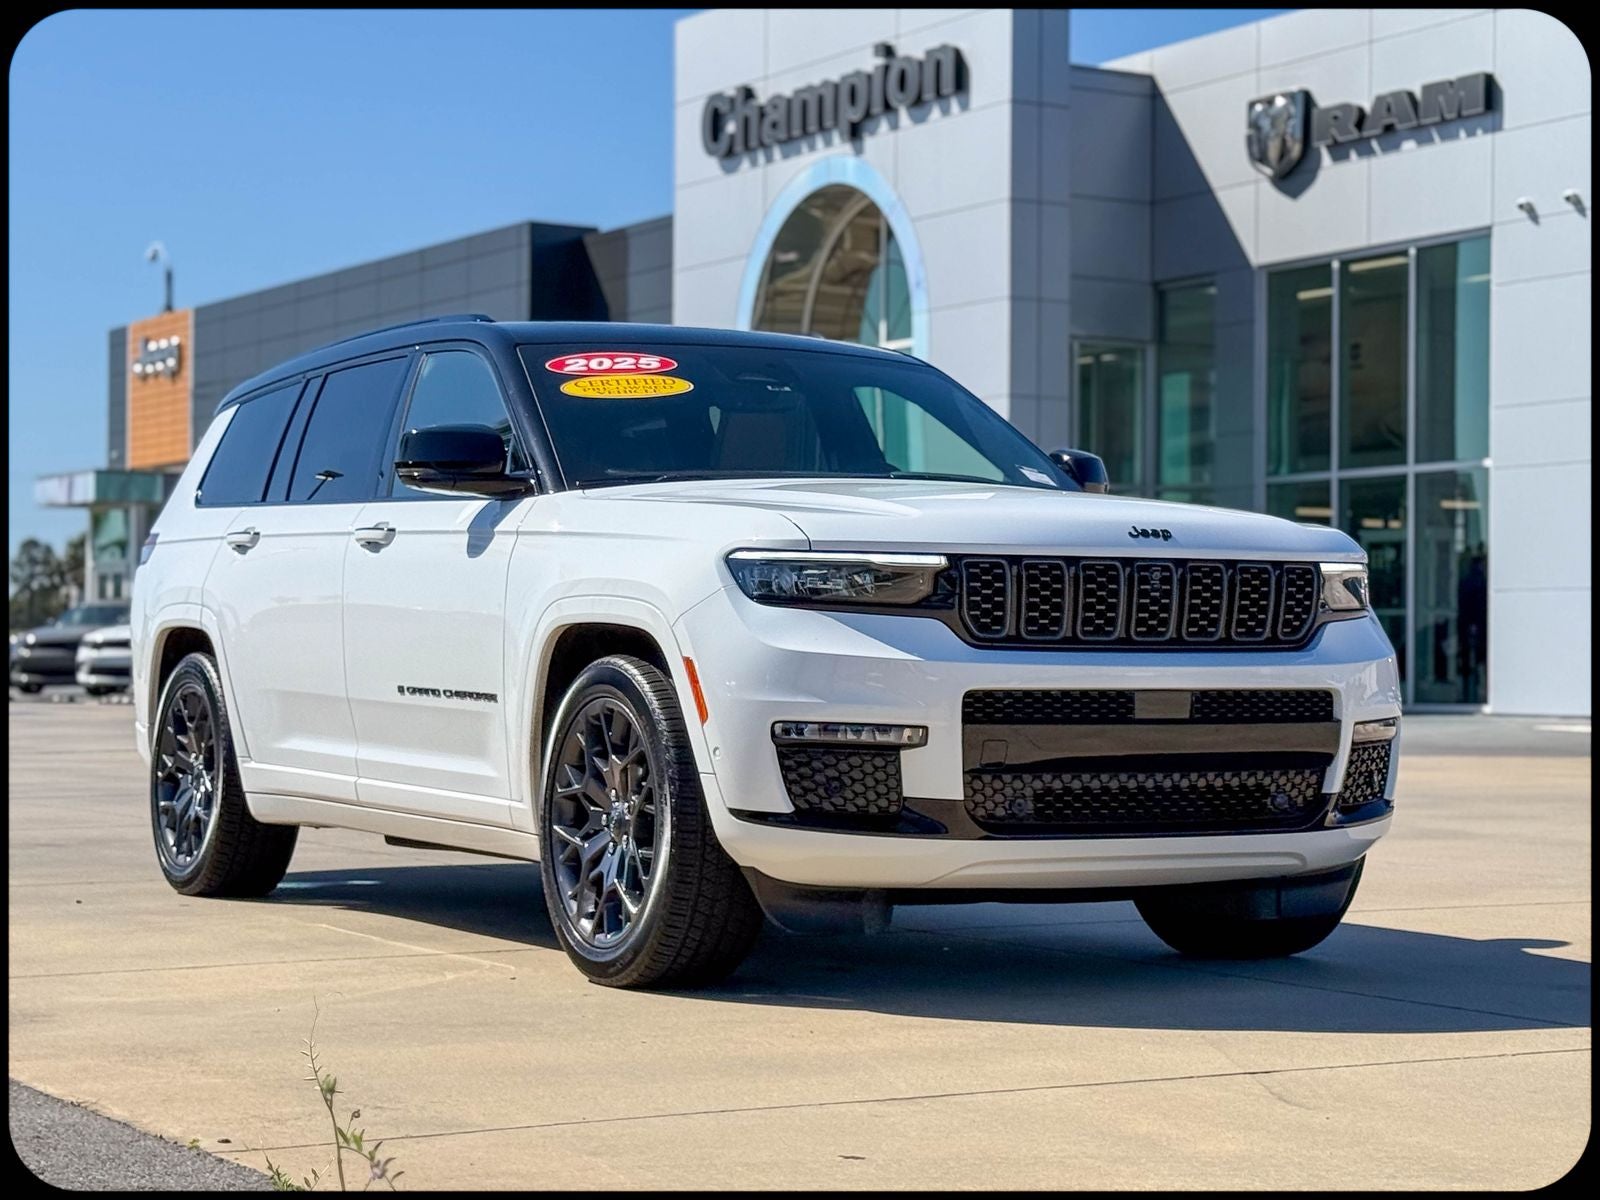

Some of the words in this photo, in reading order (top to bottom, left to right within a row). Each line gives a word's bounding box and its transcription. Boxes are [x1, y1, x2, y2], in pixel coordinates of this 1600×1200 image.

[702, 42, 965, 157] Champion
[1312, 72, 1494, 146] RAM
[563, 357, 661, 372] 2025
[574, 378, 676, 388] CERTIFIED
[1128, 525, 1172, 542] Jeep
